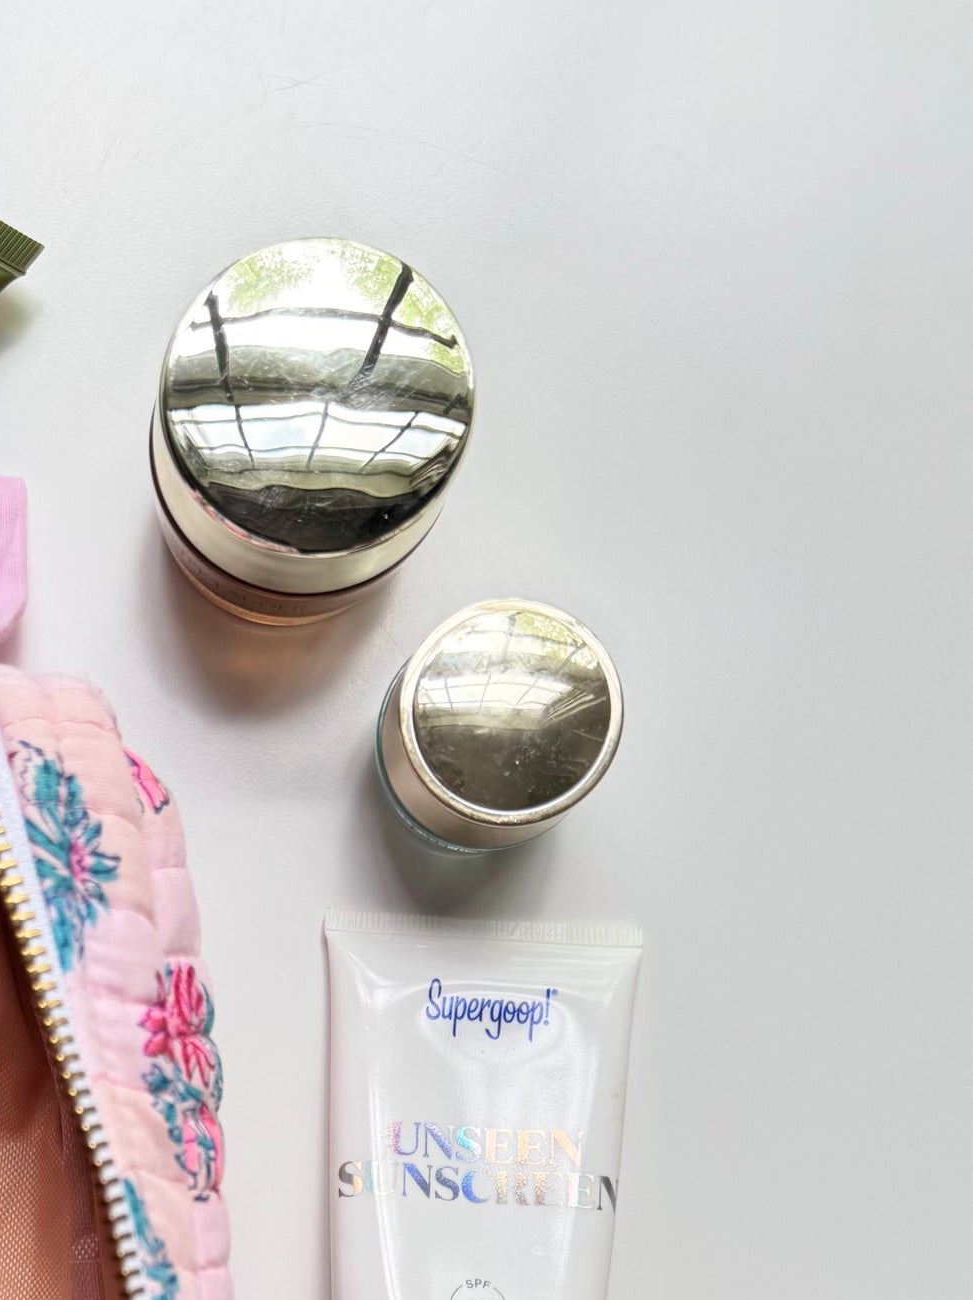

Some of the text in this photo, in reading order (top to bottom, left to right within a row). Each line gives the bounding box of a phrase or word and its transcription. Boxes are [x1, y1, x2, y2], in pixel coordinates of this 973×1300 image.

[387, 1119, 583, 1167] UNSEEN
[337, 1160, 619, 1214] SUNSCREEN
[465, 1278, 492, 1289] SPF
